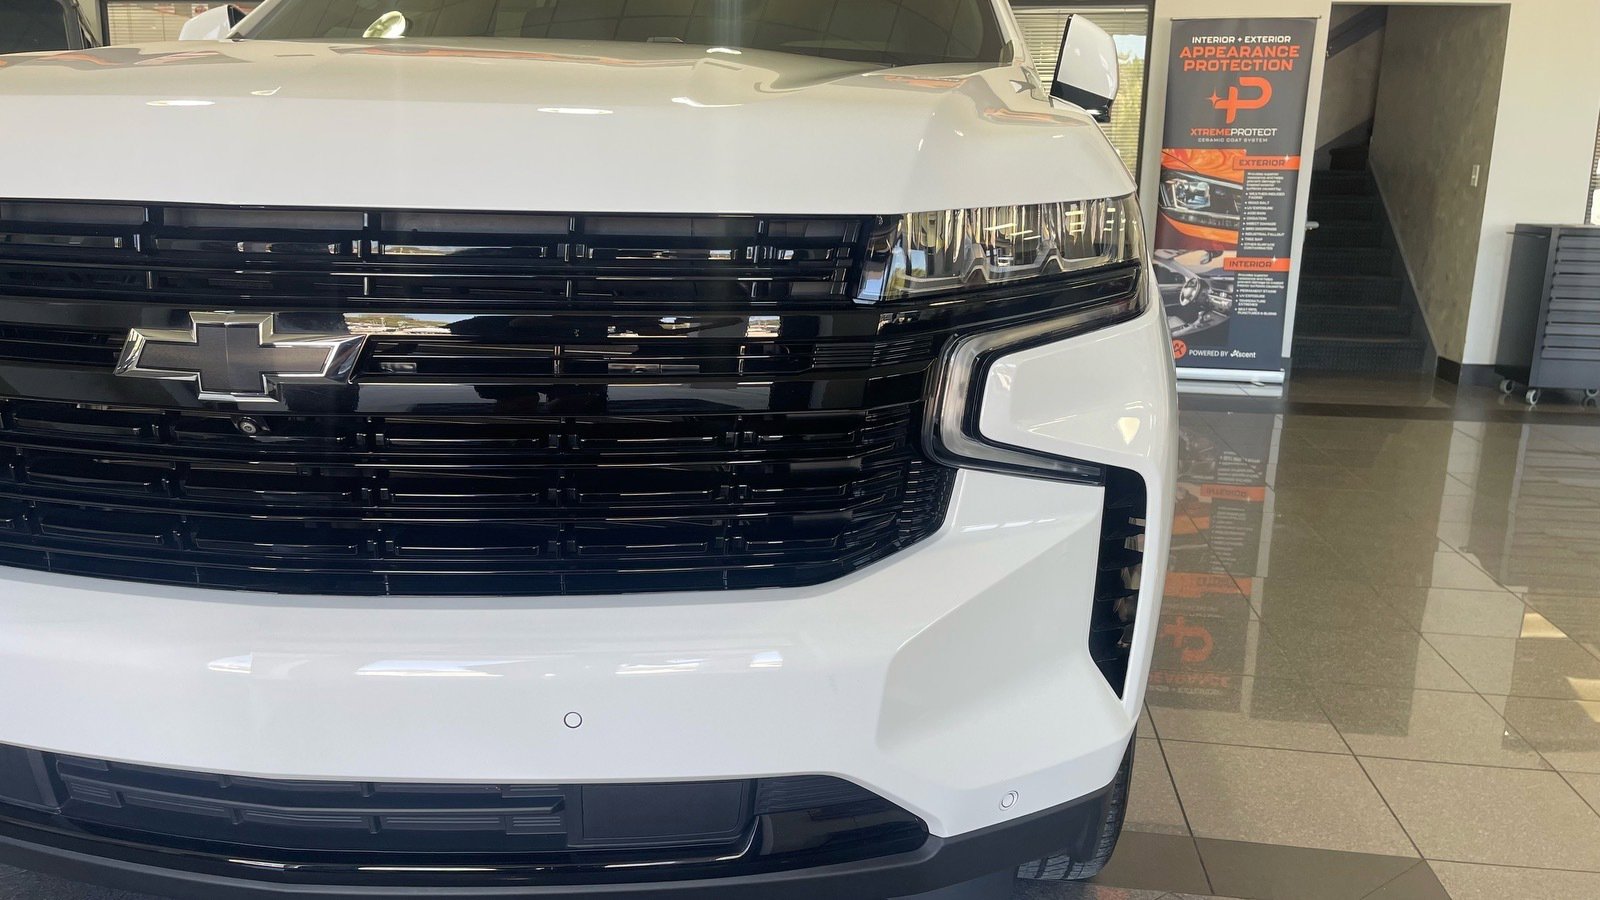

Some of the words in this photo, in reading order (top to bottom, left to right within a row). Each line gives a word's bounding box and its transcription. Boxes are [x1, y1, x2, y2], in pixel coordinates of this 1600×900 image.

[1192, 36, 1236, 44] INTERIOR
[1244, 35, 1291, 43] EXTERIOR
[1179, 45, 1300, 58] APPEARANCE
[1183, 59, 1294, 72] PROTECTION
[1190, 128, 1277, 137] XTREMEPROTECT
[1239, 159, 1285, 167] EXTERIOR
[1229, 260, 1271, 268] INTERIOR
[1189, 349, 1219, 357] POWERED
[1230, 349, 1256, 359] Ascent
